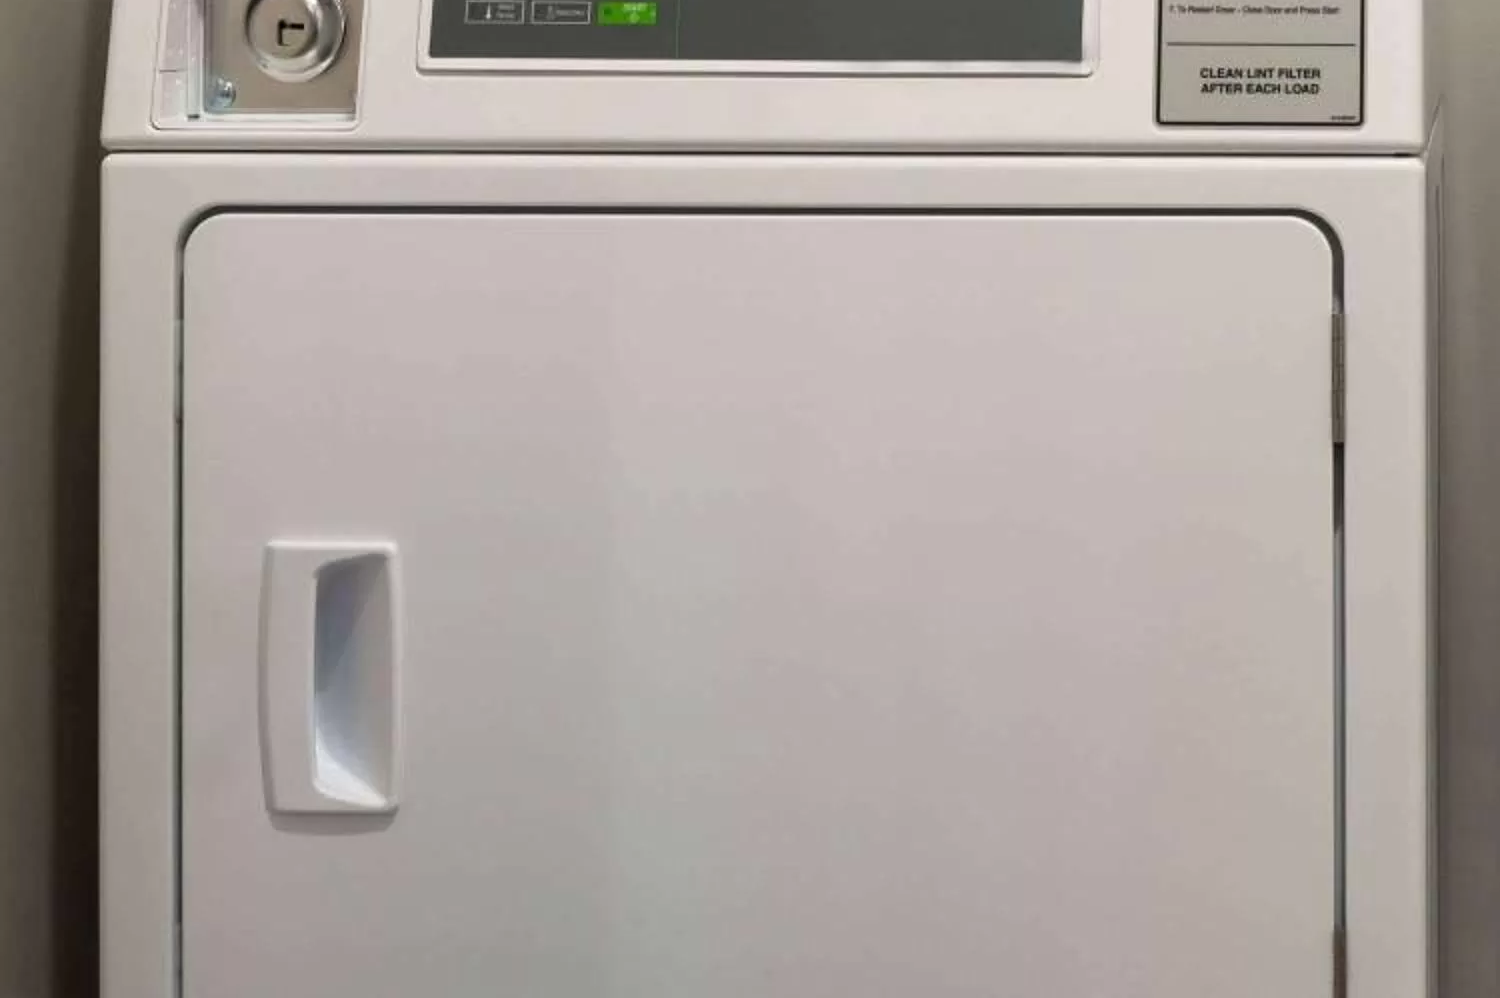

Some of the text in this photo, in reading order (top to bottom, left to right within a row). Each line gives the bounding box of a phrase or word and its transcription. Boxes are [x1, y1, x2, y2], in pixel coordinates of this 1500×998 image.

[1200, 68, 1321, 79] CLEAN LINT FILTER
[1200, 83, 1320, 95] AFTER EACH LOAD
